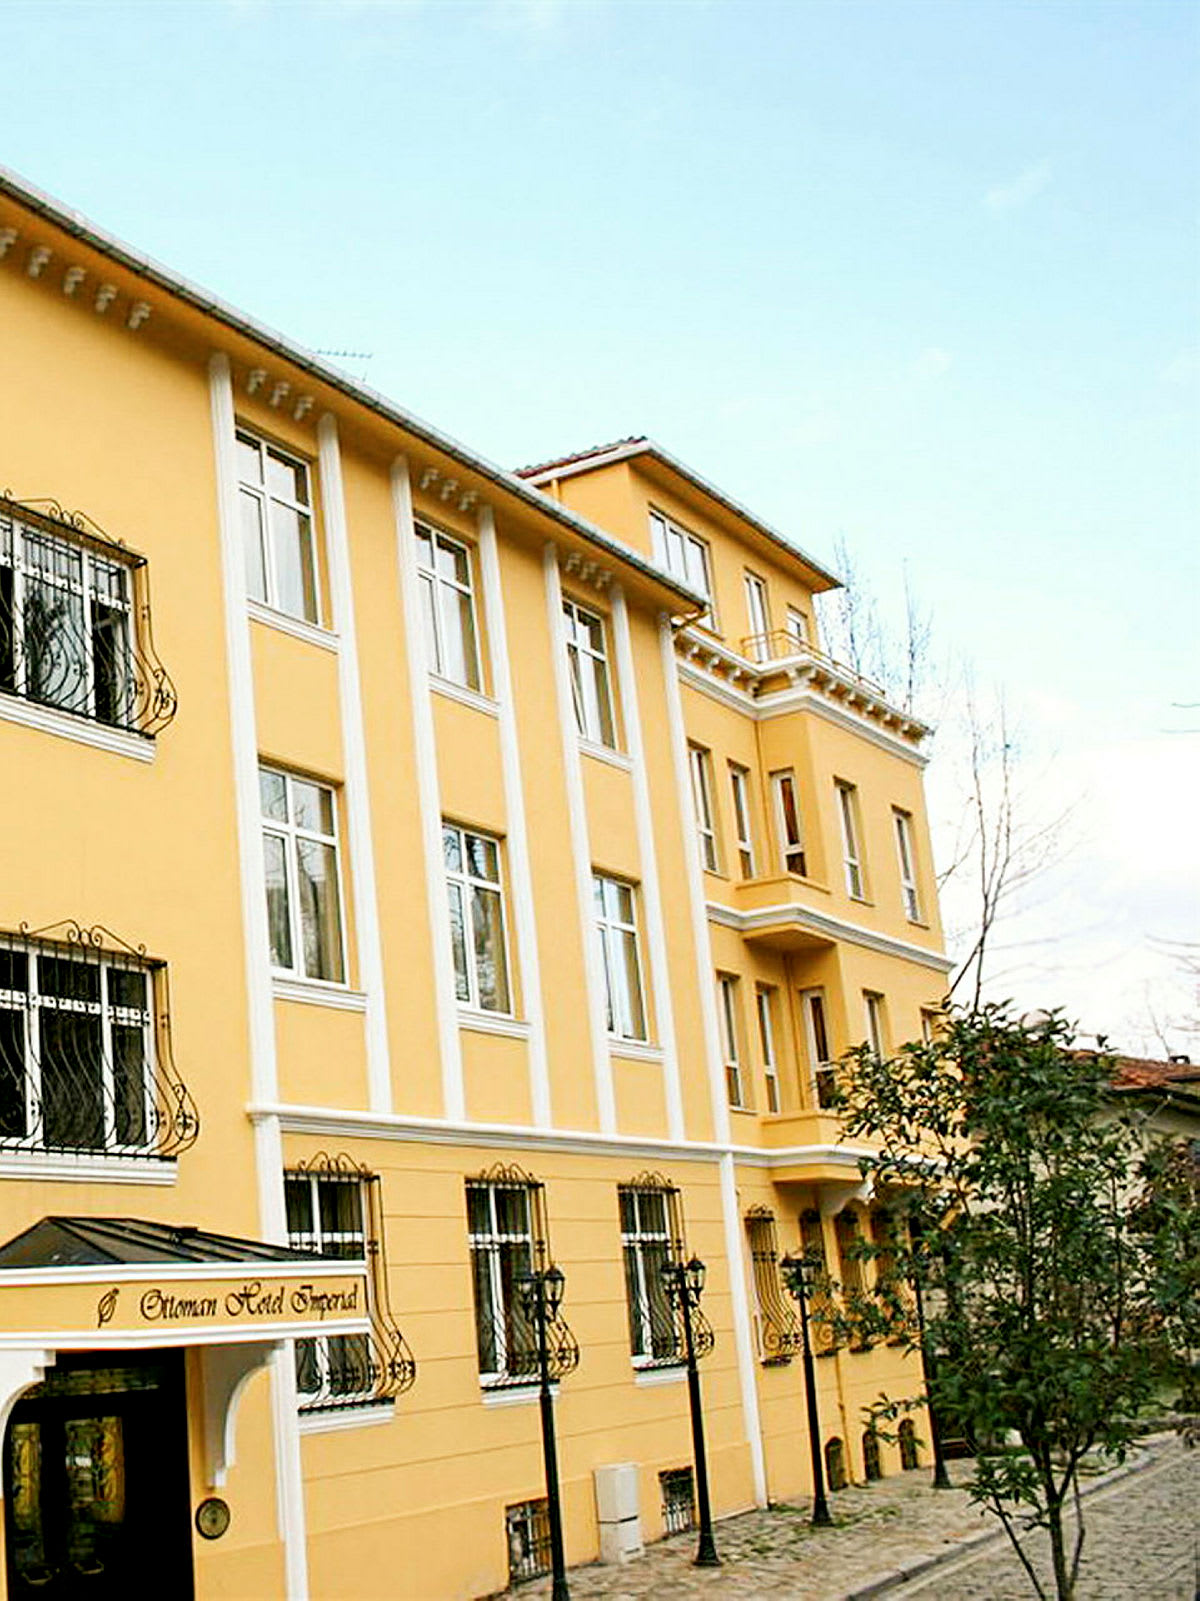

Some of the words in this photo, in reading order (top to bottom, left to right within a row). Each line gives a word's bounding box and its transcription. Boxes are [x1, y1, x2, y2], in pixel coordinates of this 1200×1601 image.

[140, 1288, 217, 1321] Ottoman
[225, 1281, 285, 1317] Hotel
[290, 1284, 358, 1320] Imperial
